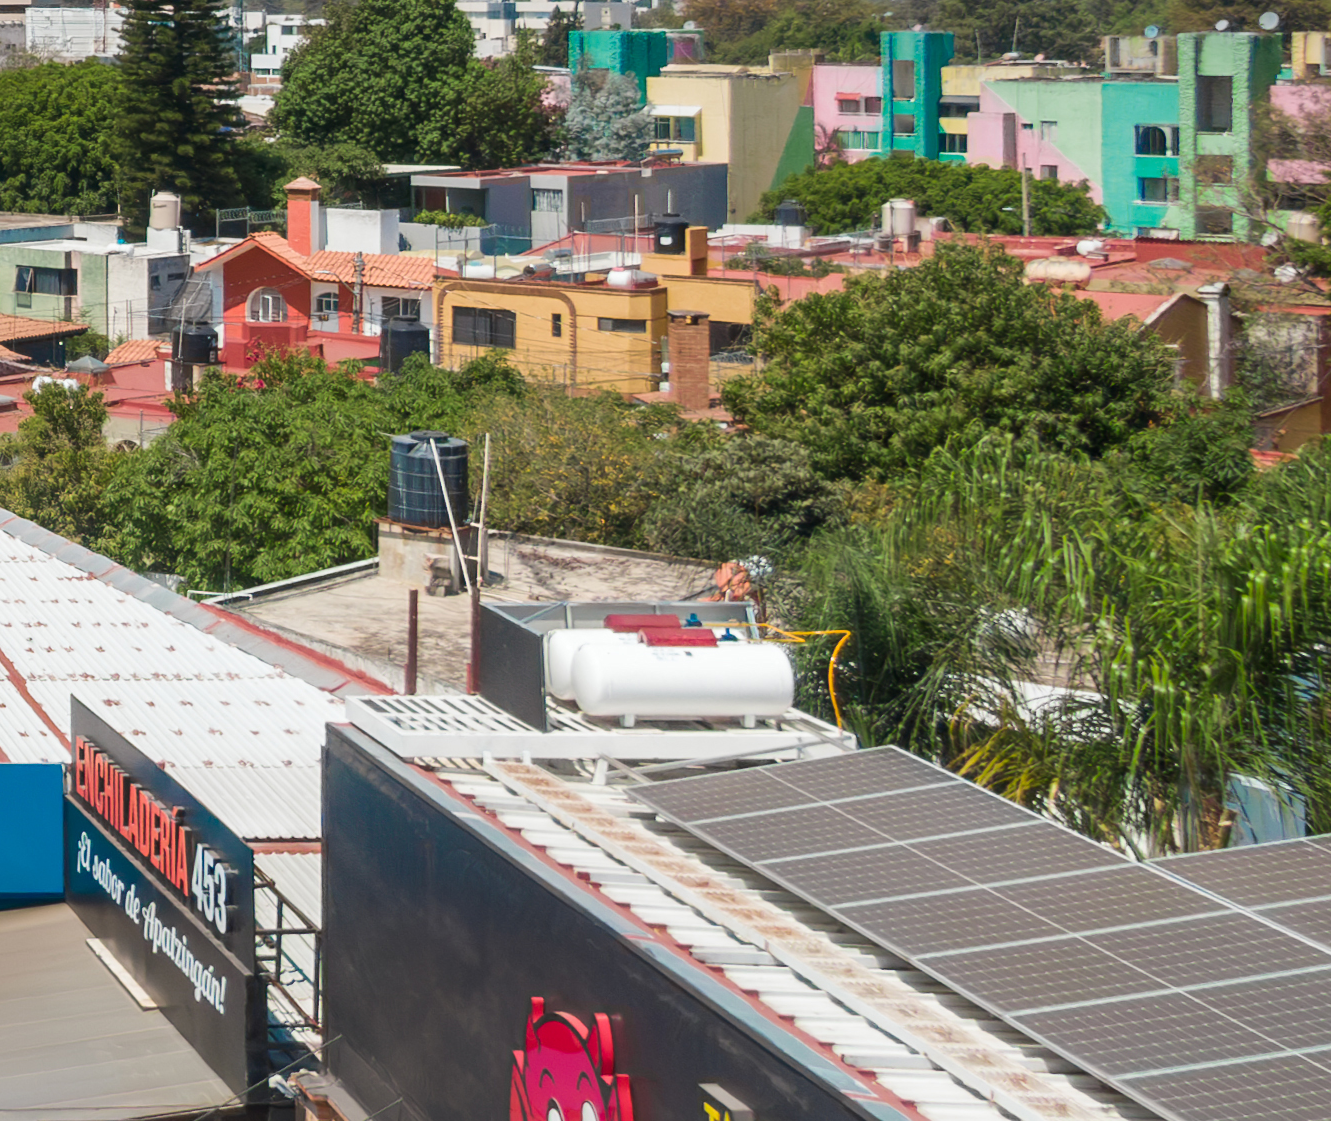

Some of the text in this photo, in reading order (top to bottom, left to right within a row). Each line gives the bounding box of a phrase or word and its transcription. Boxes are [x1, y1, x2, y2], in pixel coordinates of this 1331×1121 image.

[75, 734, 227, 934] ENCHILADERÍA 453
[92, 855, 125, 905] sabor
[124, 883, 141, 925] de
[141, 901, 228, 1015] Apatzingán!
